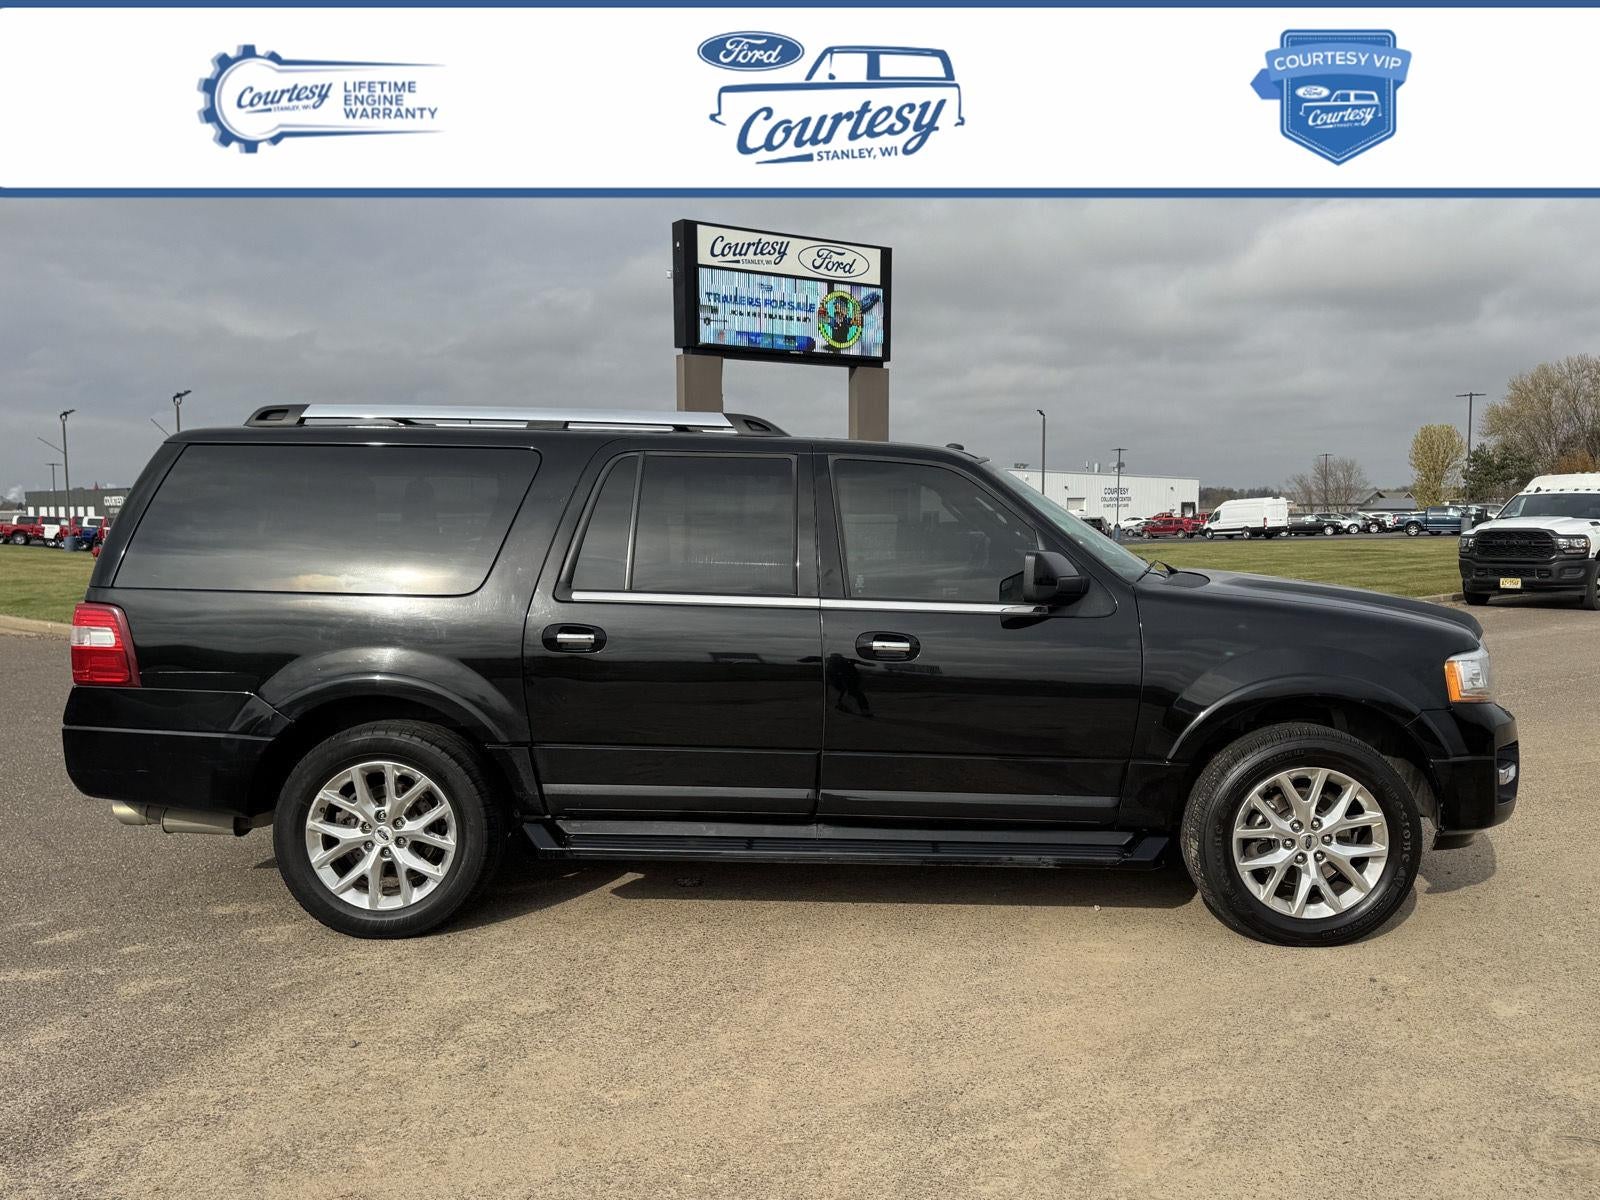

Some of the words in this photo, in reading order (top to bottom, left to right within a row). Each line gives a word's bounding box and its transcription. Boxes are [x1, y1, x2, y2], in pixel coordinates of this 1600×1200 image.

[710, 235, 790, 266] Courtesy
[811, 247, 857, 275] Ford
[705, 291, 761, 307] TRAILERS
[763, 298, 787, 310] FOR
[787, 301, 816, 313] SALE
